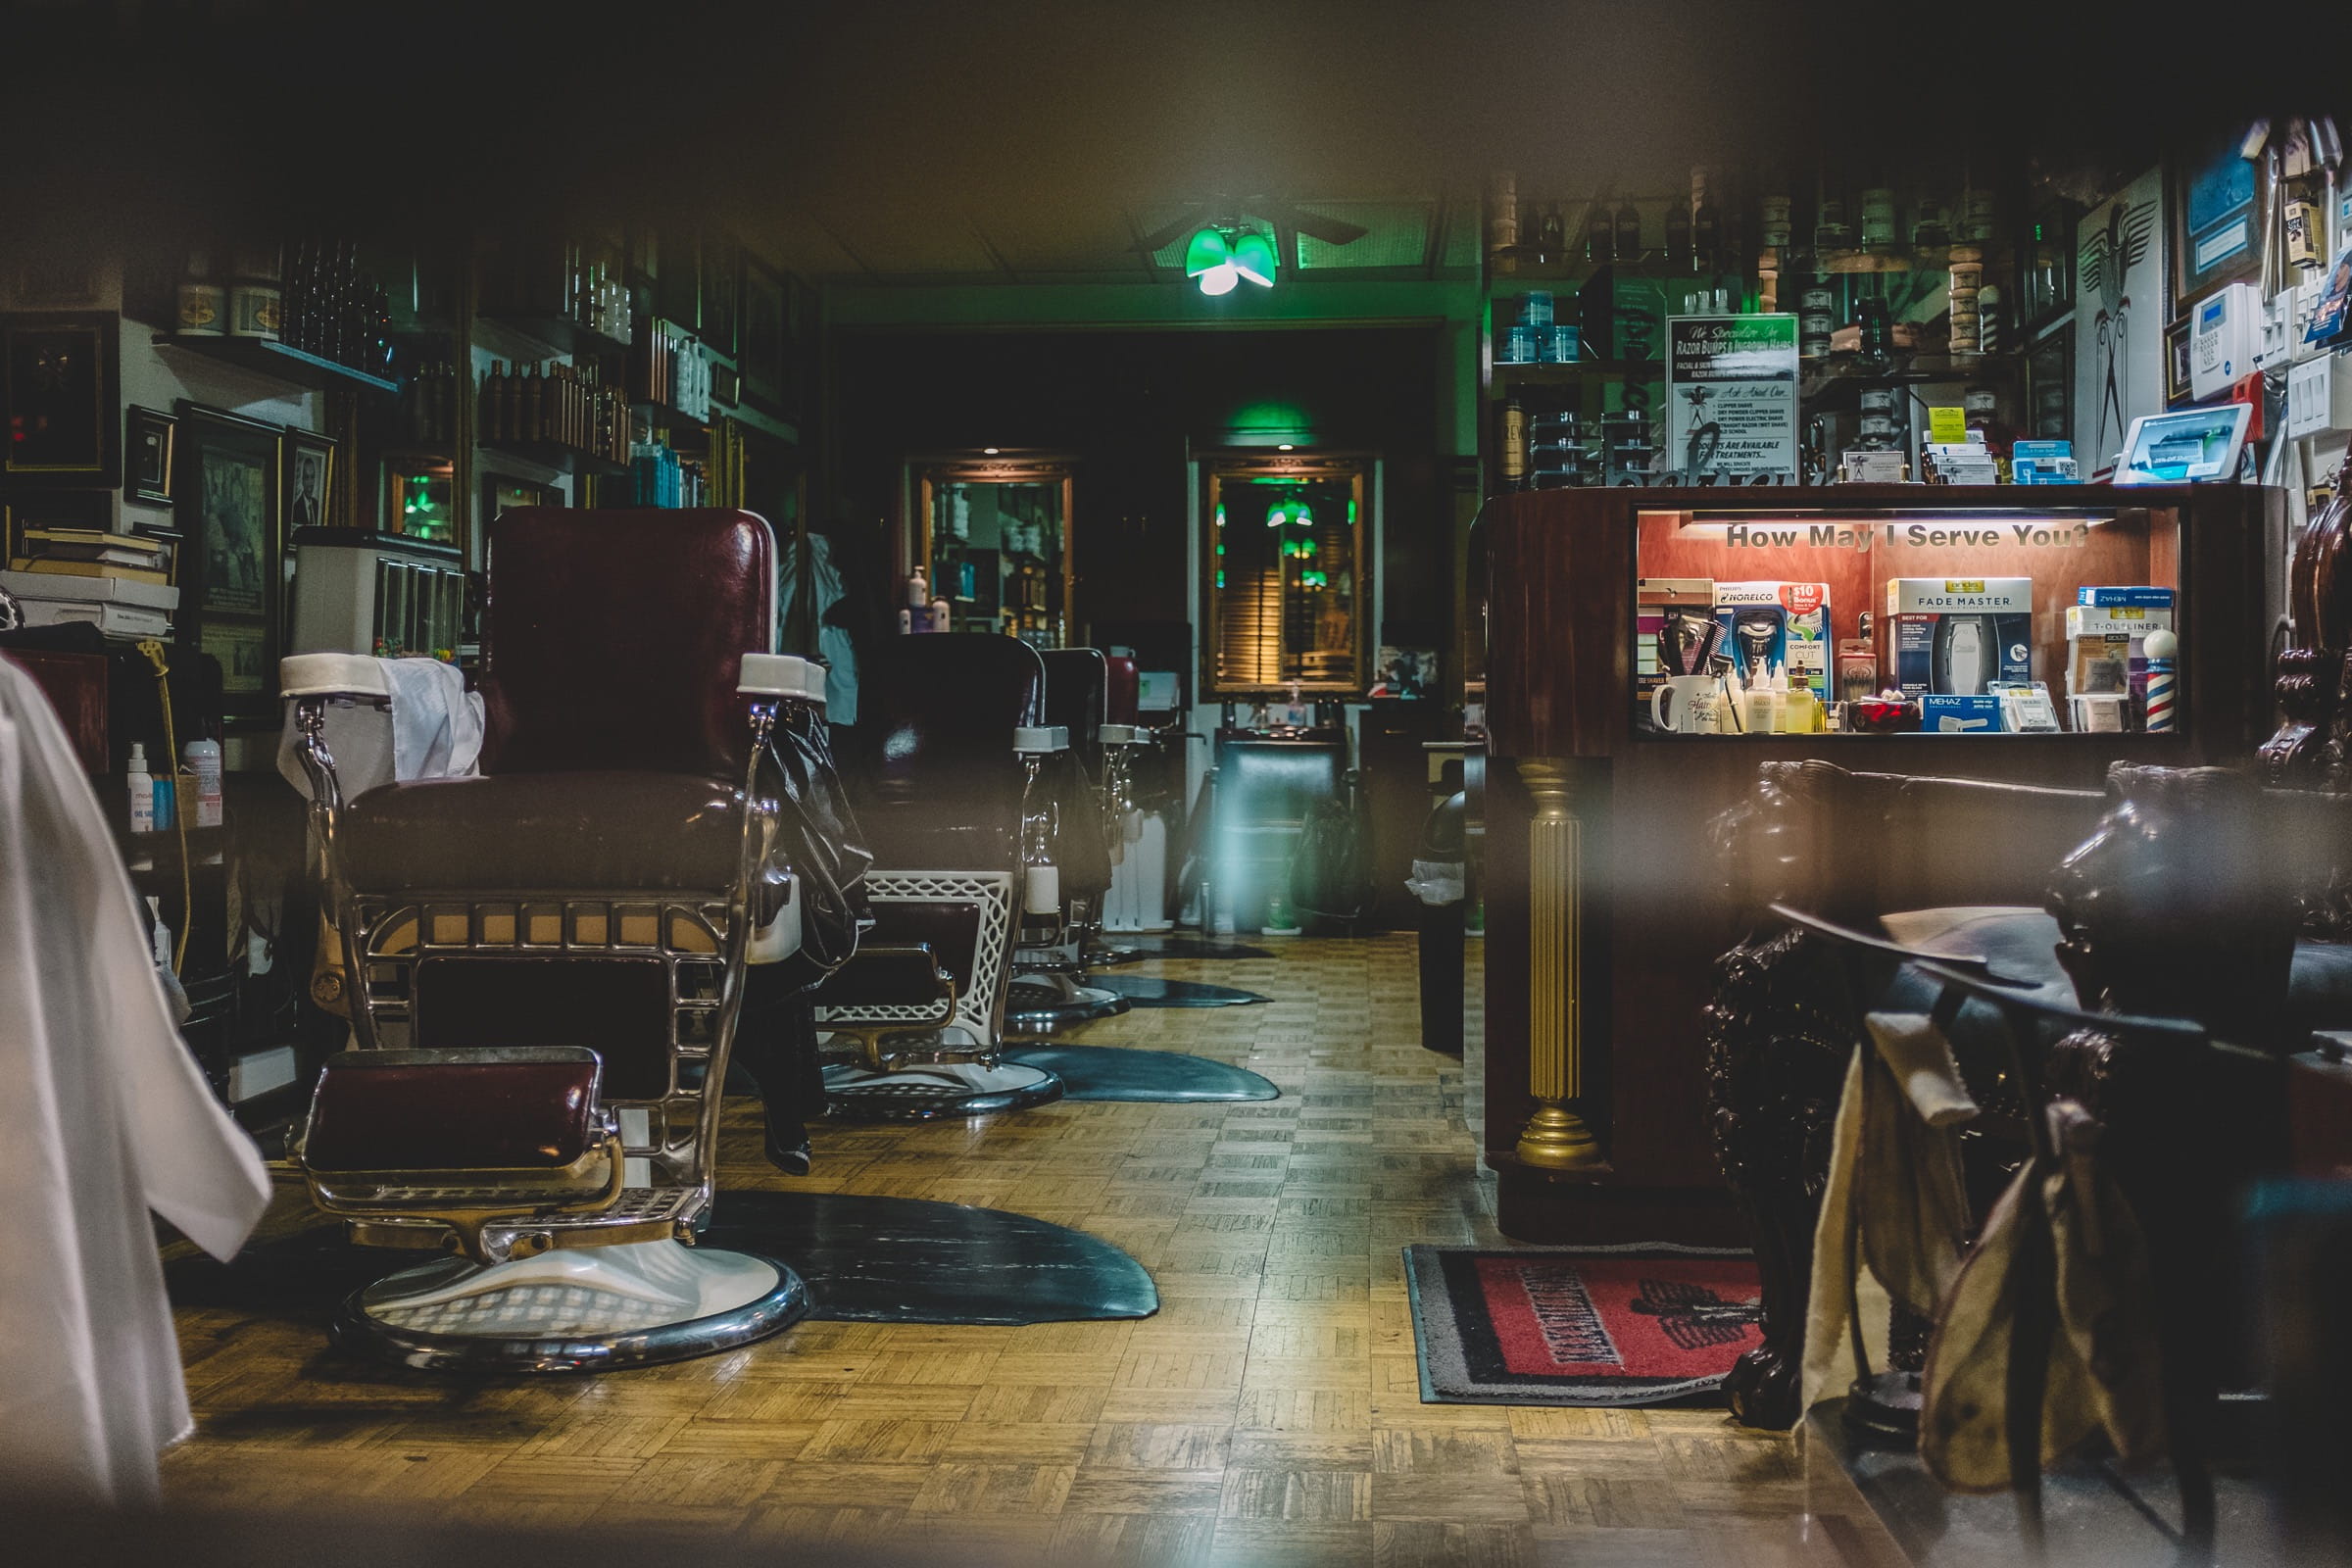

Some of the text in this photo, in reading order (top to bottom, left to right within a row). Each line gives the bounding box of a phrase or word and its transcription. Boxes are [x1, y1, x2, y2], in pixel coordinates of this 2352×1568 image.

[1724, 441, 1740, 450] ARE
[1740, 440, 1780, 450] AVAILABLE
[1727, 524, 2089, 553] How May I Serve You?
[1793, 586, 1814, 597] $10
[1729, 593, 1773, 602] NORELCO
[1918, 597, 2011, 606] FADE MASTER
[1795, 651, 1816, 660] CUT
